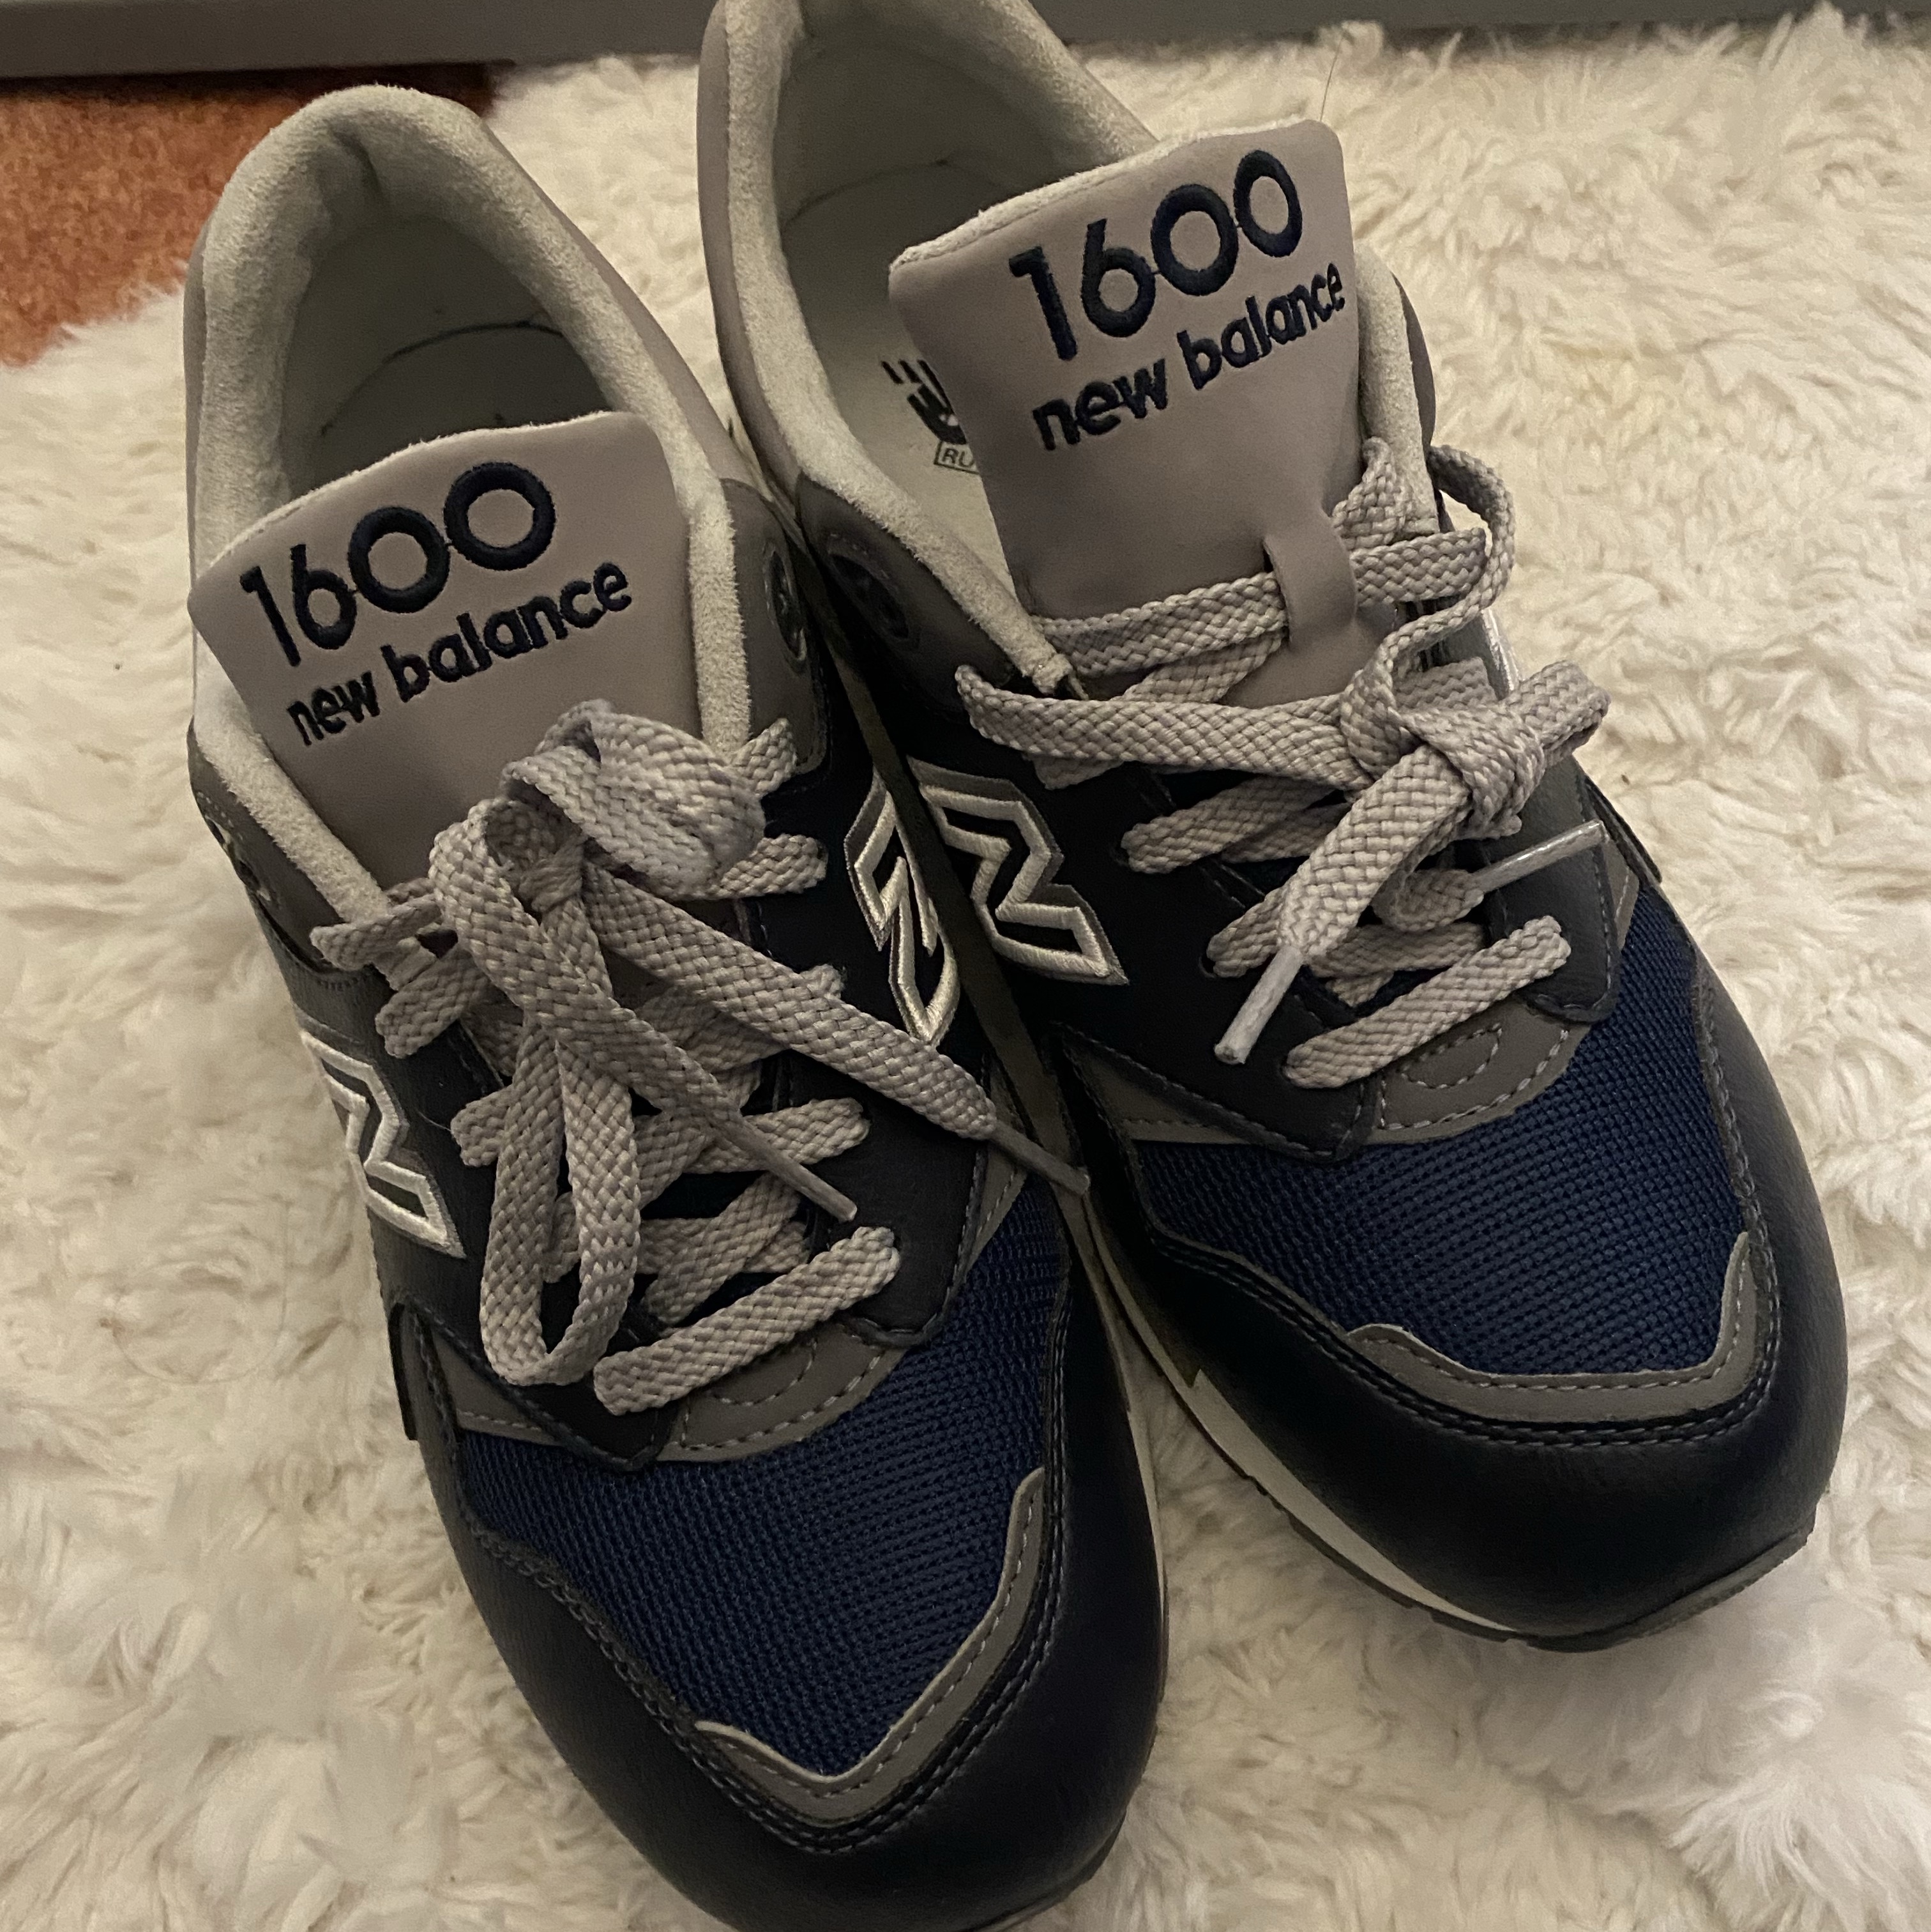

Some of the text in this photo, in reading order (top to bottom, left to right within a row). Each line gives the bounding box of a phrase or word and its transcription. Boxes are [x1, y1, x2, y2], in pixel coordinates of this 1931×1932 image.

[1008, 149, 1303, 361] 1600
[1033, 359, 1168, 451] new
[1176, 262, 1345, 391] balance
[239, 462, 557, 667] 1600
[287, 562, 633, 747] new balance
